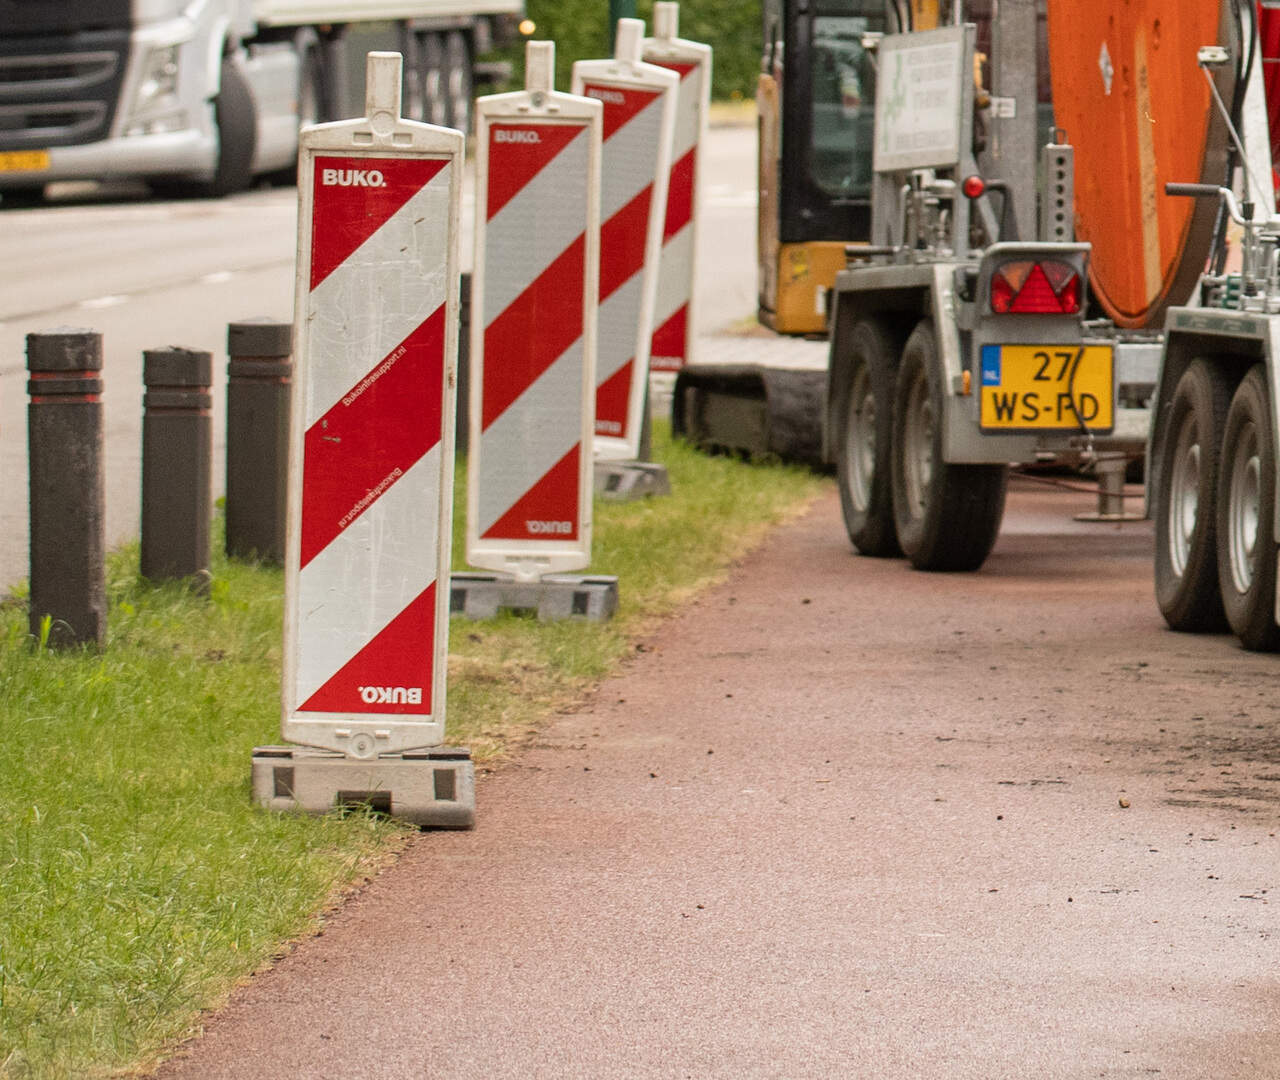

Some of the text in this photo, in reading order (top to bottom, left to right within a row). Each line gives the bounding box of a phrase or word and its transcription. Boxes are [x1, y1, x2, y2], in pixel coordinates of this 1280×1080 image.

[323, 168, 387, 187] BUKO.
[342, 346, 407, 407] Bukoinfrasupport.nl
[1033, 351, 1074, 382] 27
[338, 467, 403, 528] Bukoinfrasupport.nl
[358, 686, 422, 704] BUKO.
